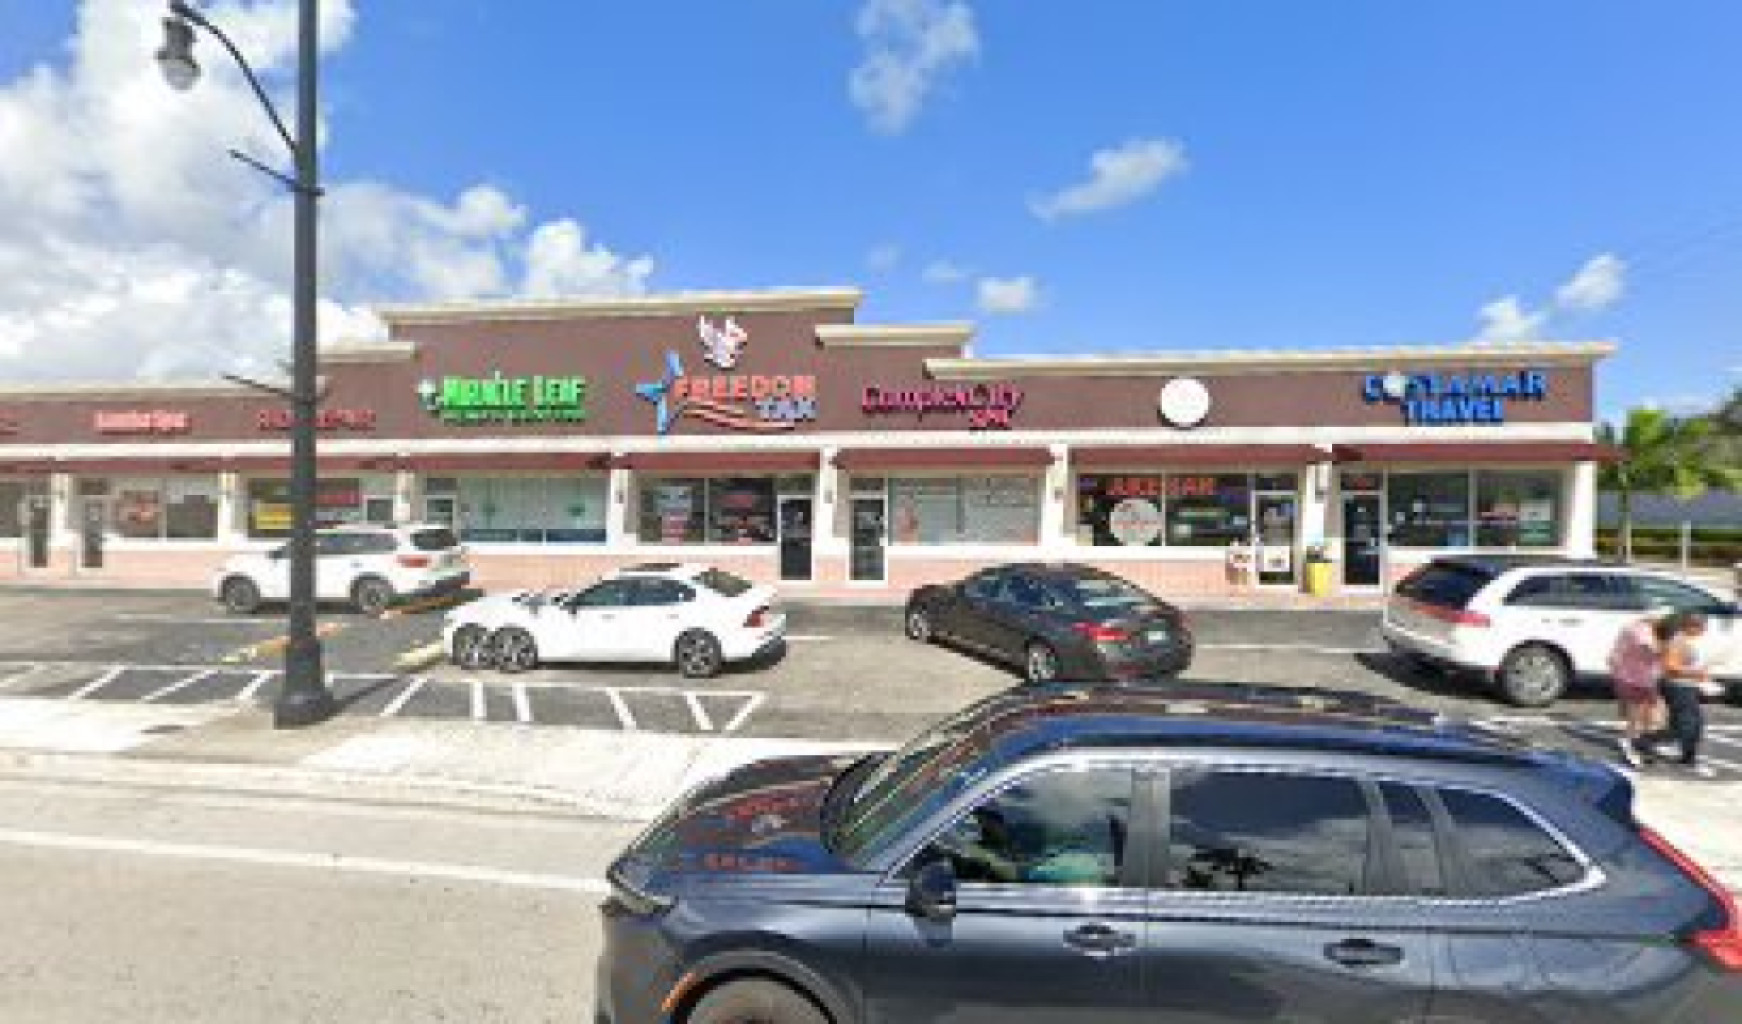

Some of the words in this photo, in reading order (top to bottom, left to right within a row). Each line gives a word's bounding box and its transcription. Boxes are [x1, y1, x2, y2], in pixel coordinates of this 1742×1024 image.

[533, 375, 586, 405] LEAF
[674, 376, 818, 402] FREEDOM
[755, 398, 818, 421] TAX
[1405, 398, 1504, 422] TRAVEL
